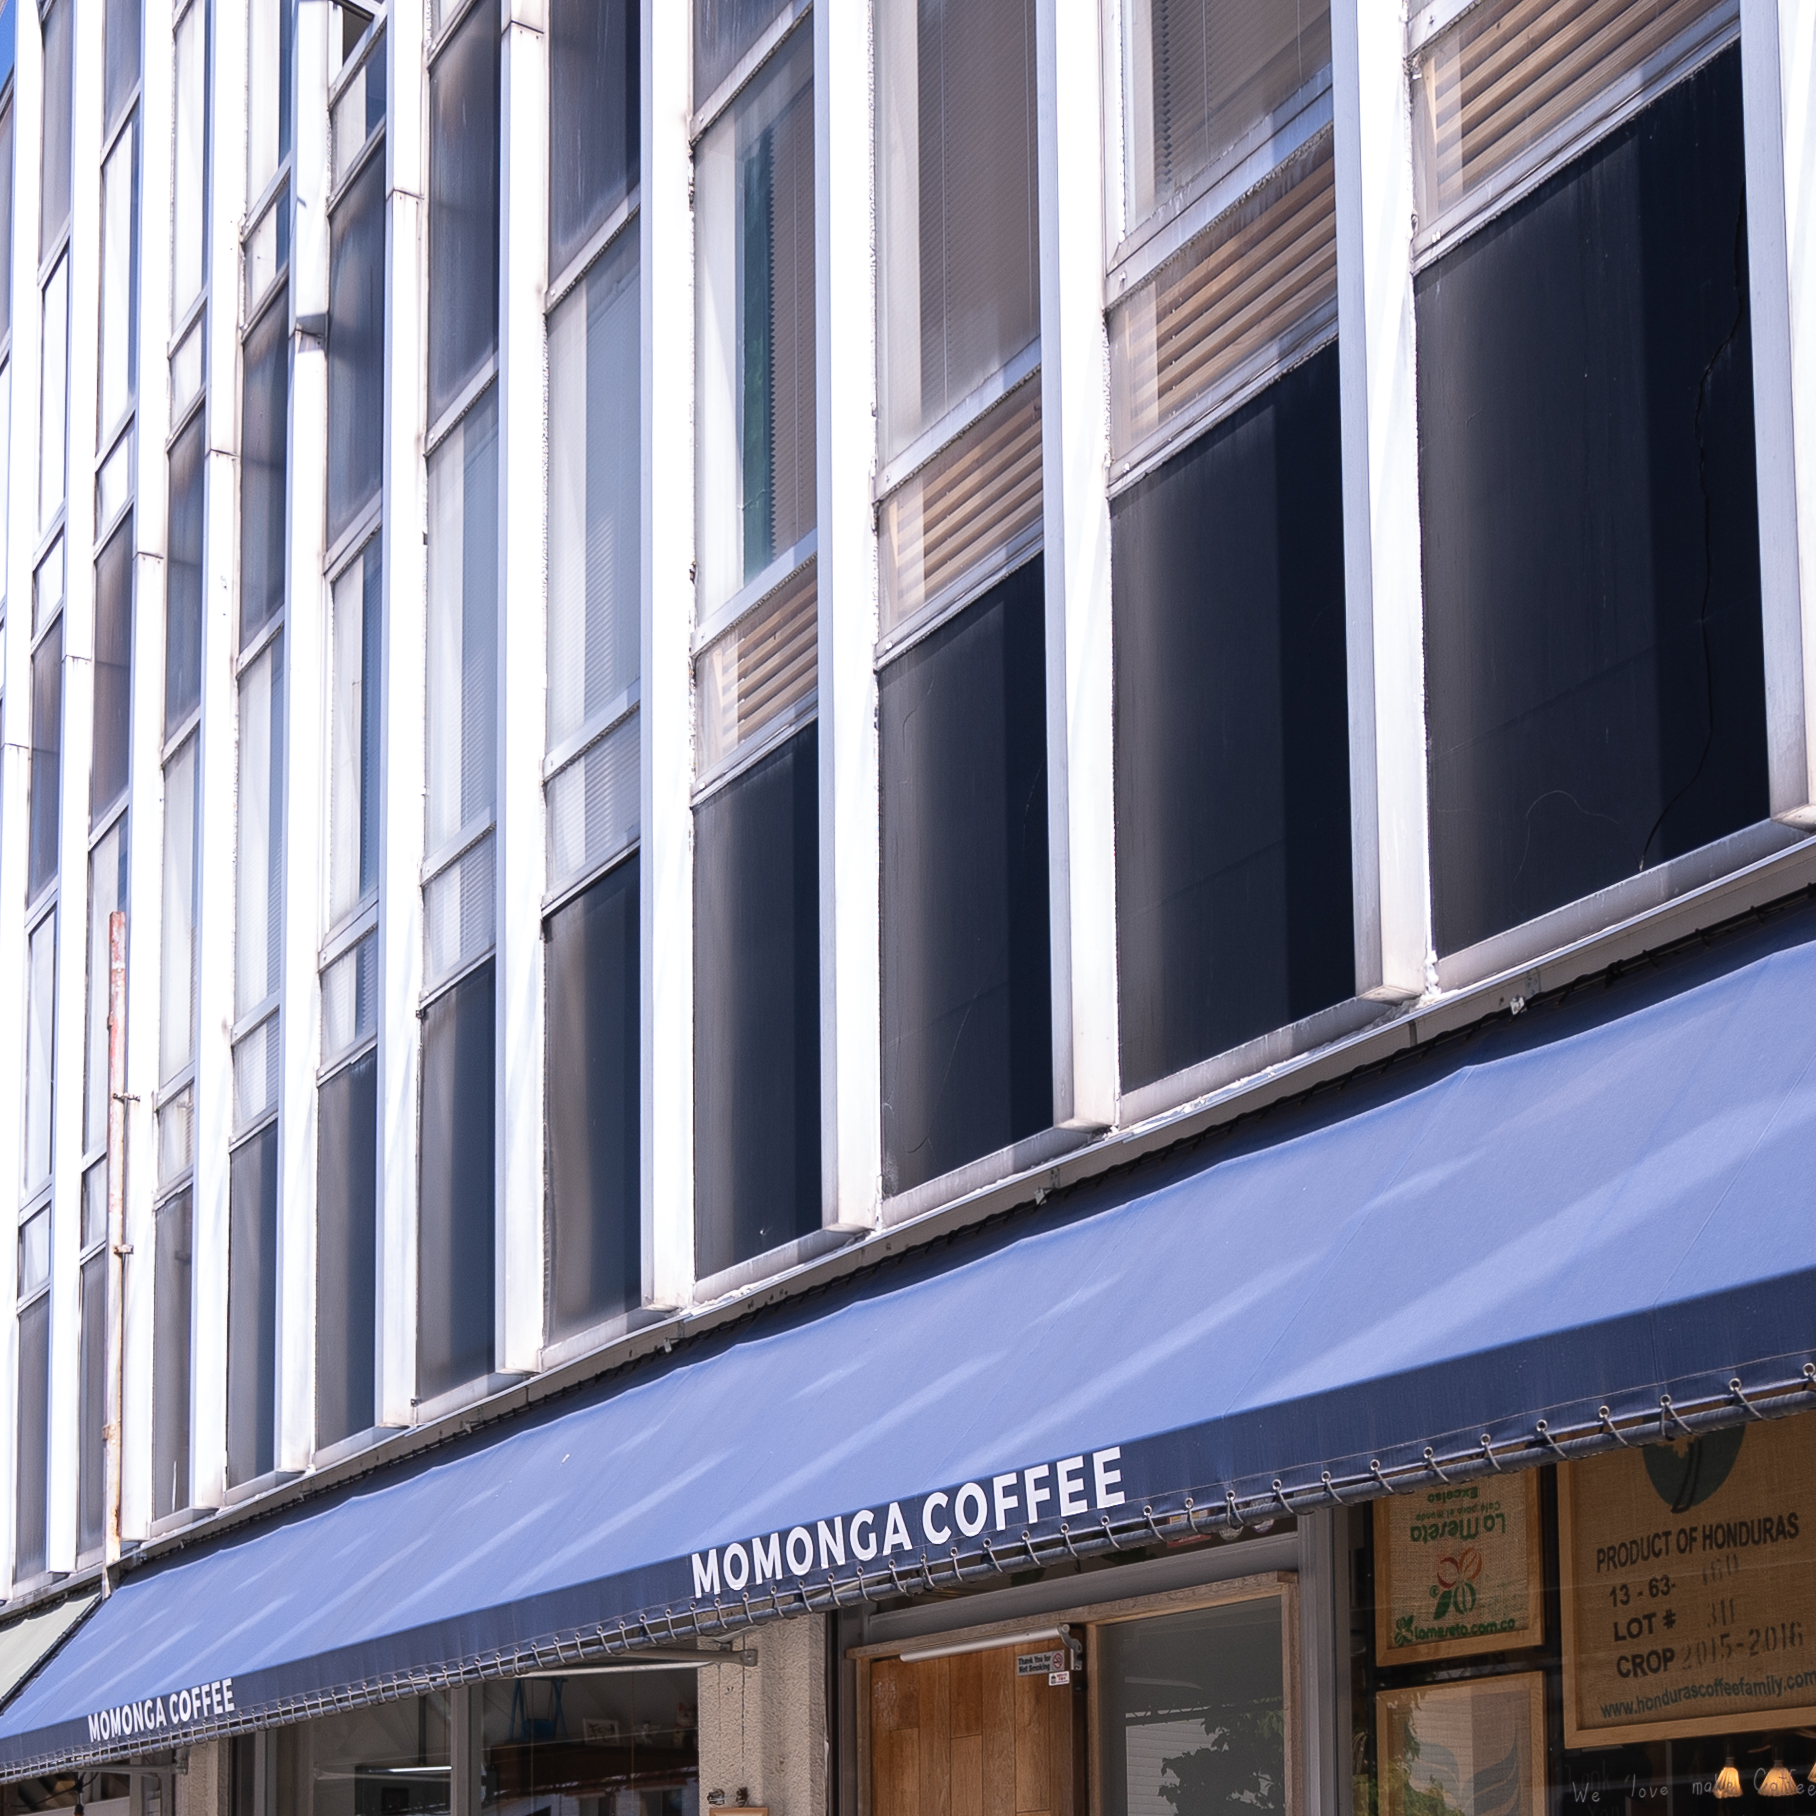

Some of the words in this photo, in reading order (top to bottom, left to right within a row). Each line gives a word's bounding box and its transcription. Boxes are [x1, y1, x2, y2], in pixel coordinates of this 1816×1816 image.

[691, 1501, 912, 1599] MOMONGA
[921, 1445, 1126, 1546] COFFEE
[1596, 1530, 1673, 1574] PRODUCT
[1676, 1526, 1699, 1554] OF
[1702, 1511, 1800, 1552] HONDURAS
[1613, 1611, 1658, 1643] LOT
[1662, 1608, 1677, 1631] #
[1616, 1646, 1676, 1679] CROP
[1681, 1620, 1804, 1671] 2015-2016
[87, 1696, 168, 1743] MOMONGA
[169, 1677, 235, 1724] COFFEE
[1572, 1782, 1602, 1803] We
